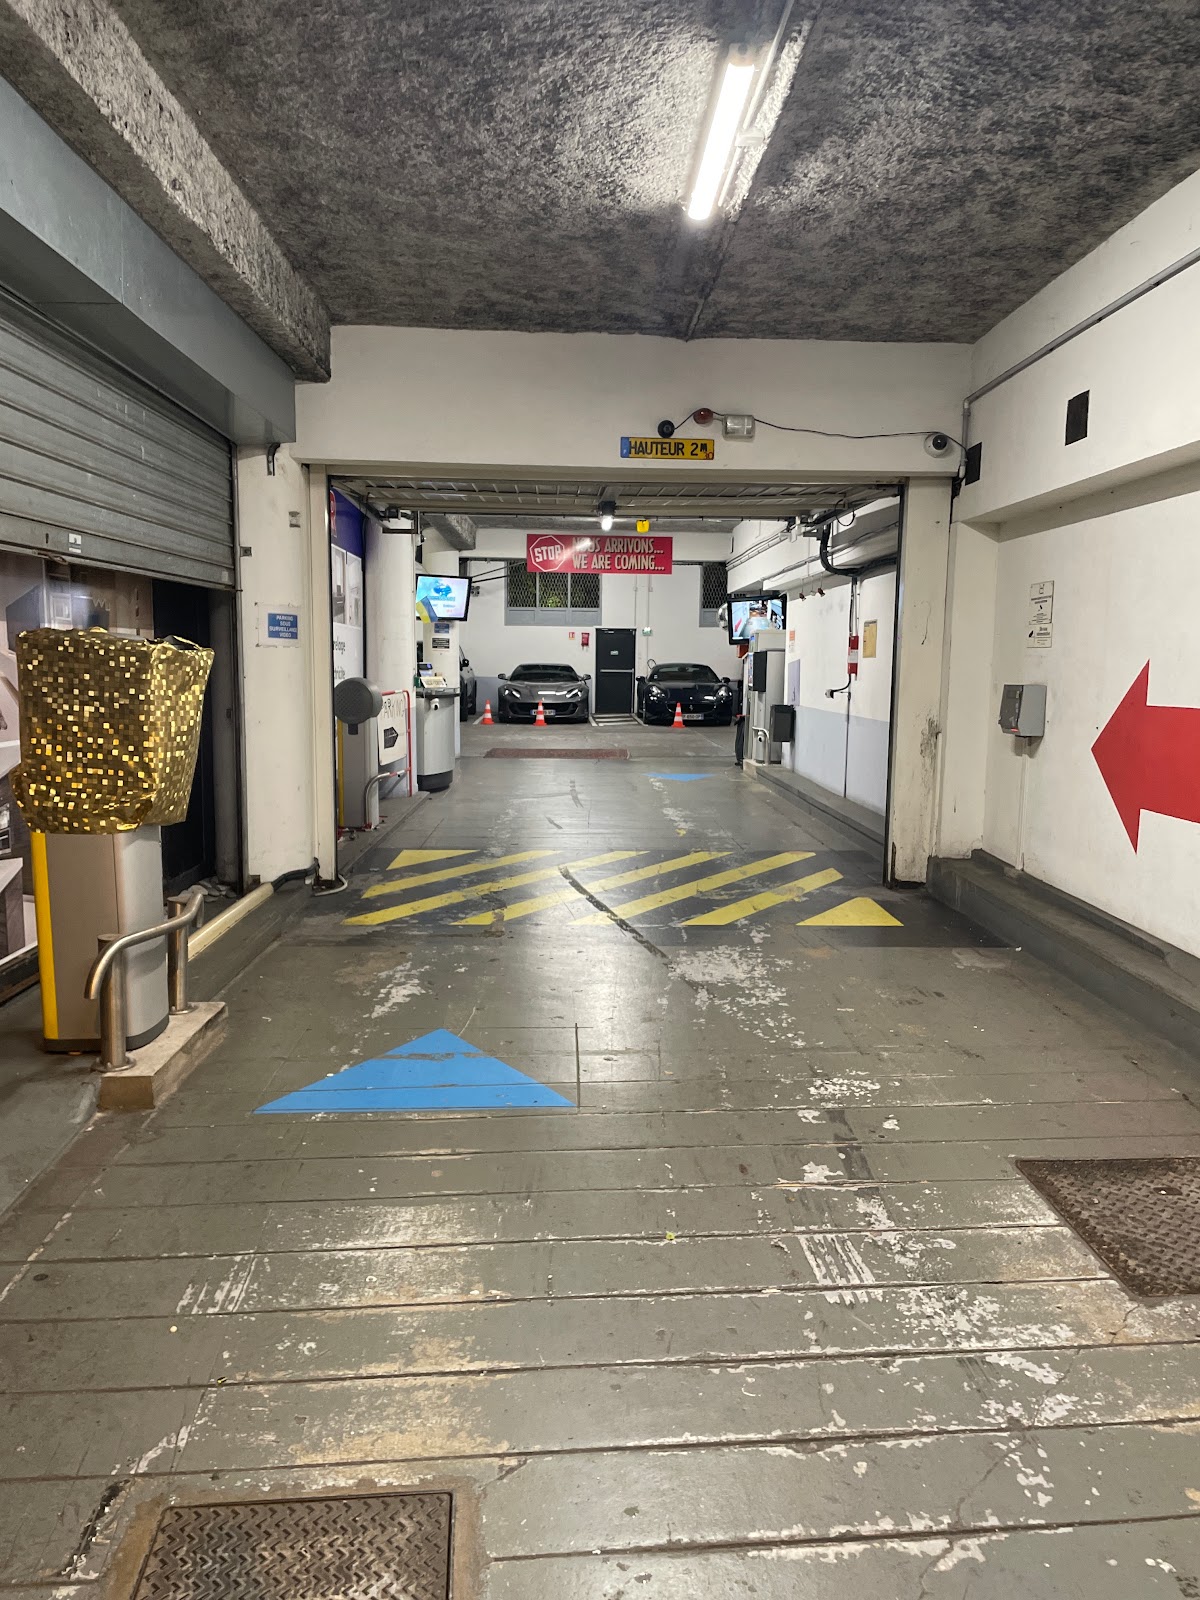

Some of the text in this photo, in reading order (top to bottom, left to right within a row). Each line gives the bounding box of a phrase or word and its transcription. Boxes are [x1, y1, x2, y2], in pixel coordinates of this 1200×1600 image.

[629, 440, 685, 456] HAUTEUR
[534, 544, 561, 563] STOP
[604, 537, 664, 554] ARRIVONS...
[573, 554, 665, 570] WE ARE COMING...
